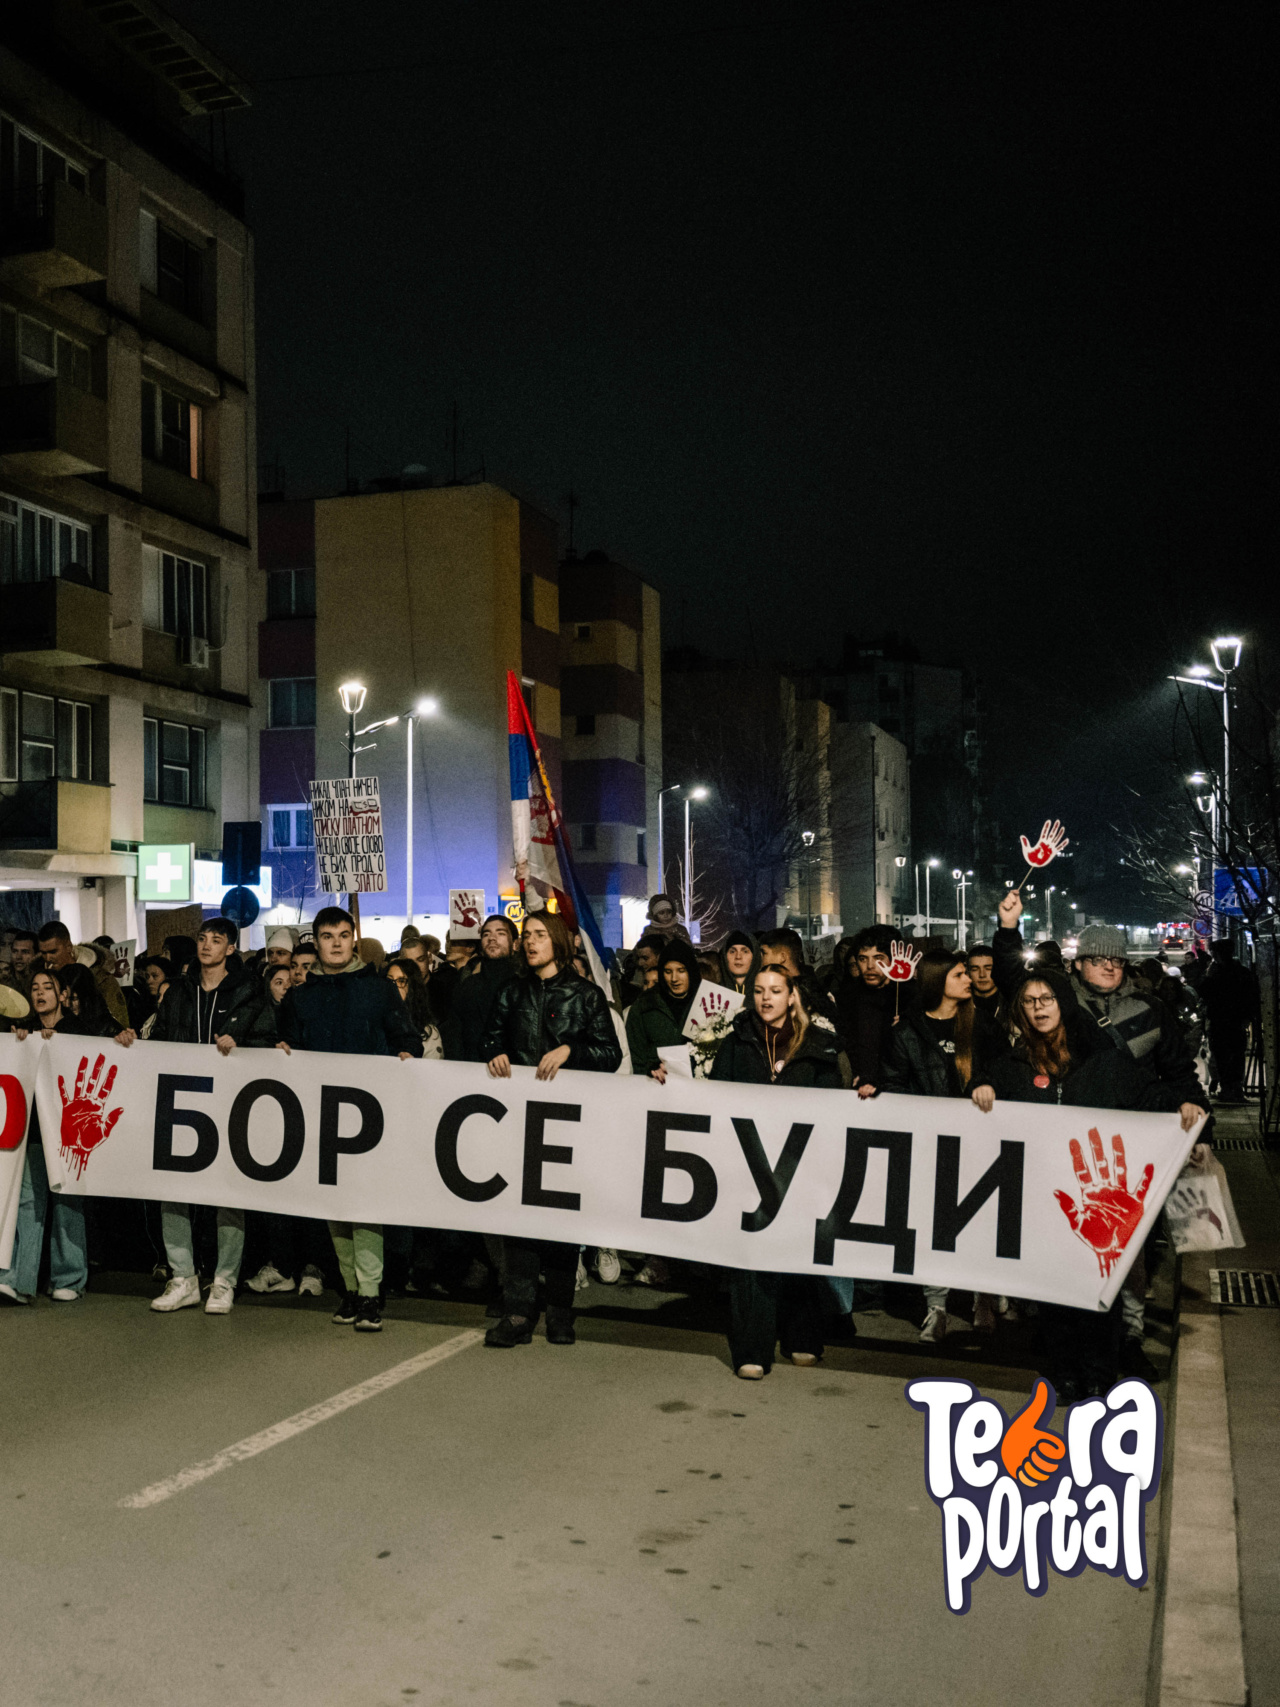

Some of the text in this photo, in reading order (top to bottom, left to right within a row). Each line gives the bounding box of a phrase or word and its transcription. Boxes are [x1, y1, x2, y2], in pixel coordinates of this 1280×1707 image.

[312, 799, 350, 817] НИКОМ НА
[314, 816, 380, 836] СПИСКУ ПЛАТНОМ
[361, 835, 383, 854] СЛОВО
[318, 855, 327, 873] НЕ
[330, 855, 348, 873] БИХ
[321, 873, 383, 892] НИ ЗА ЗЛАТО
[153, 1072, 1026, 1275] БОР СЕ БУДИ
